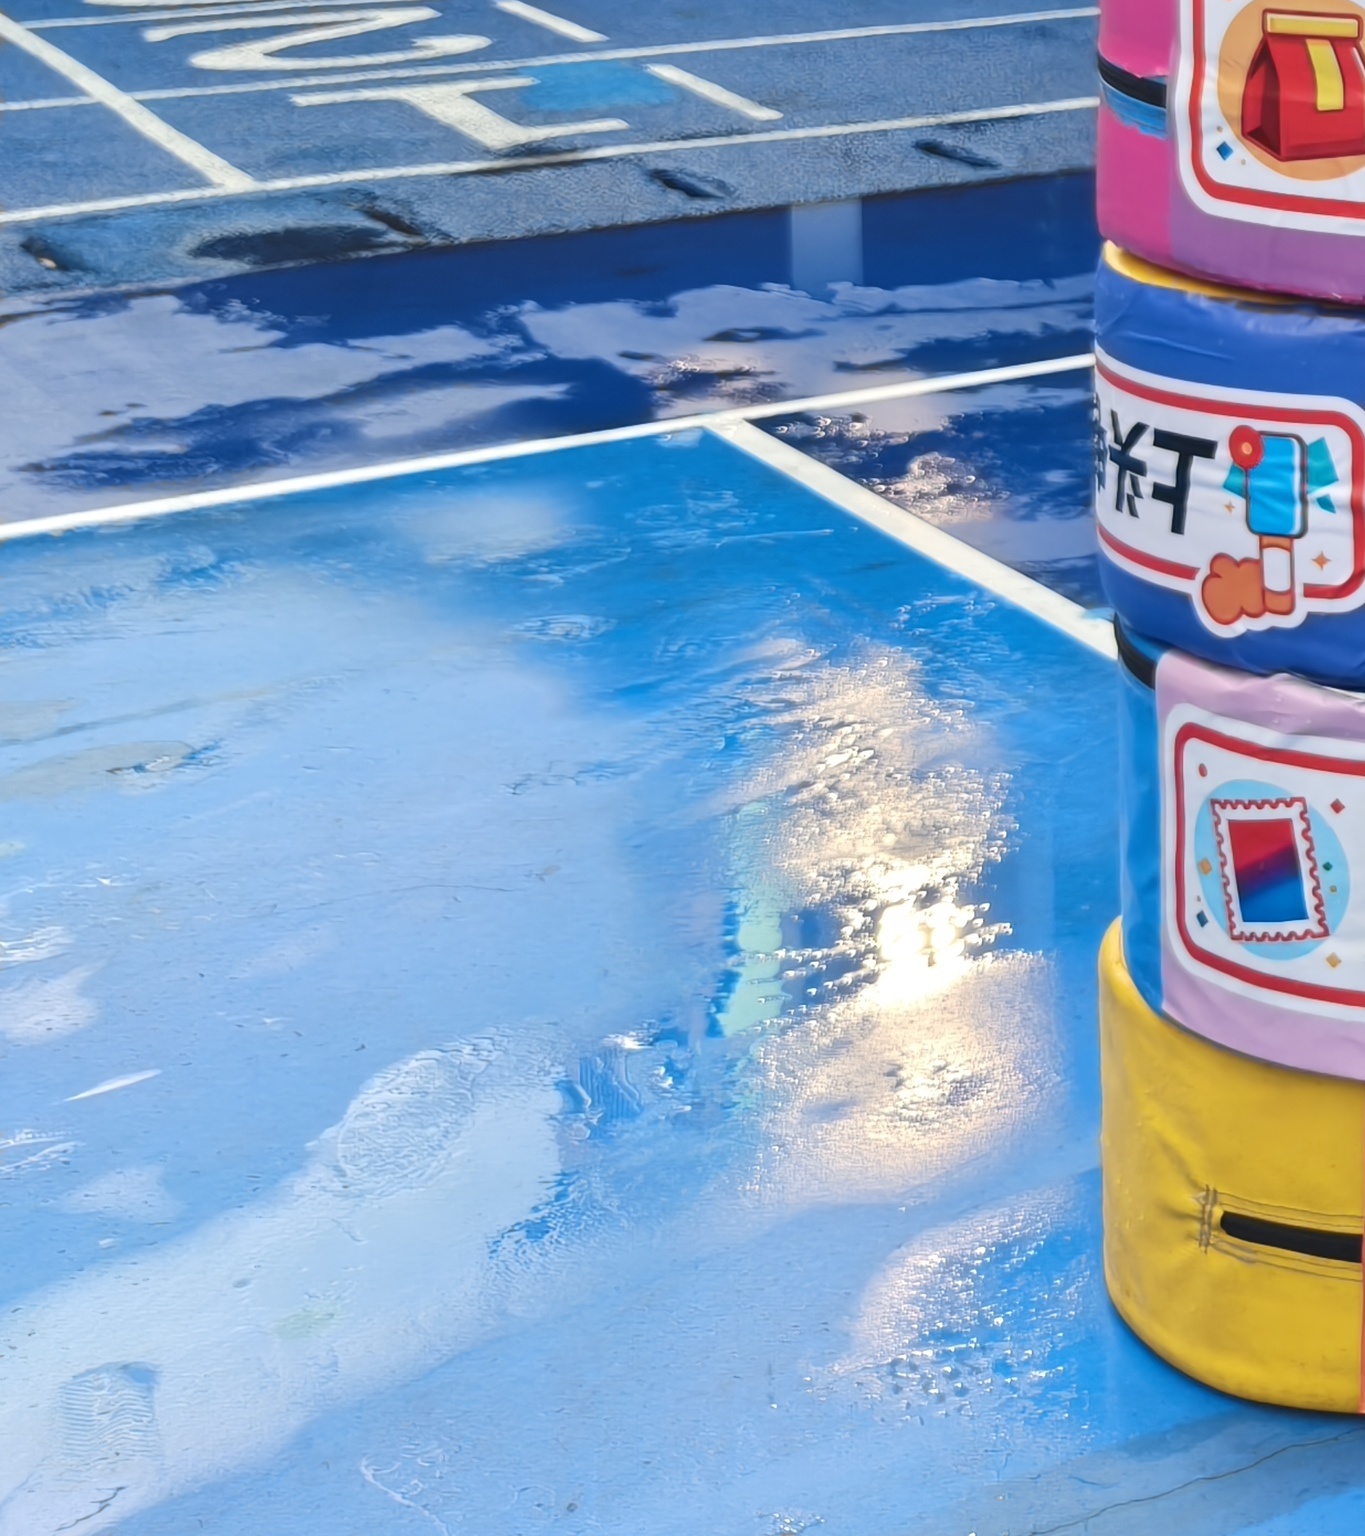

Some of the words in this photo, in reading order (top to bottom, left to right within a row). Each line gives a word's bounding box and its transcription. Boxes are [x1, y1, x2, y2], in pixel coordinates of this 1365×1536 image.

[141, 6, 494, 72] 2
[289, 76, 630, 151] 1
[1094, 391, 1219, 536] 上头
